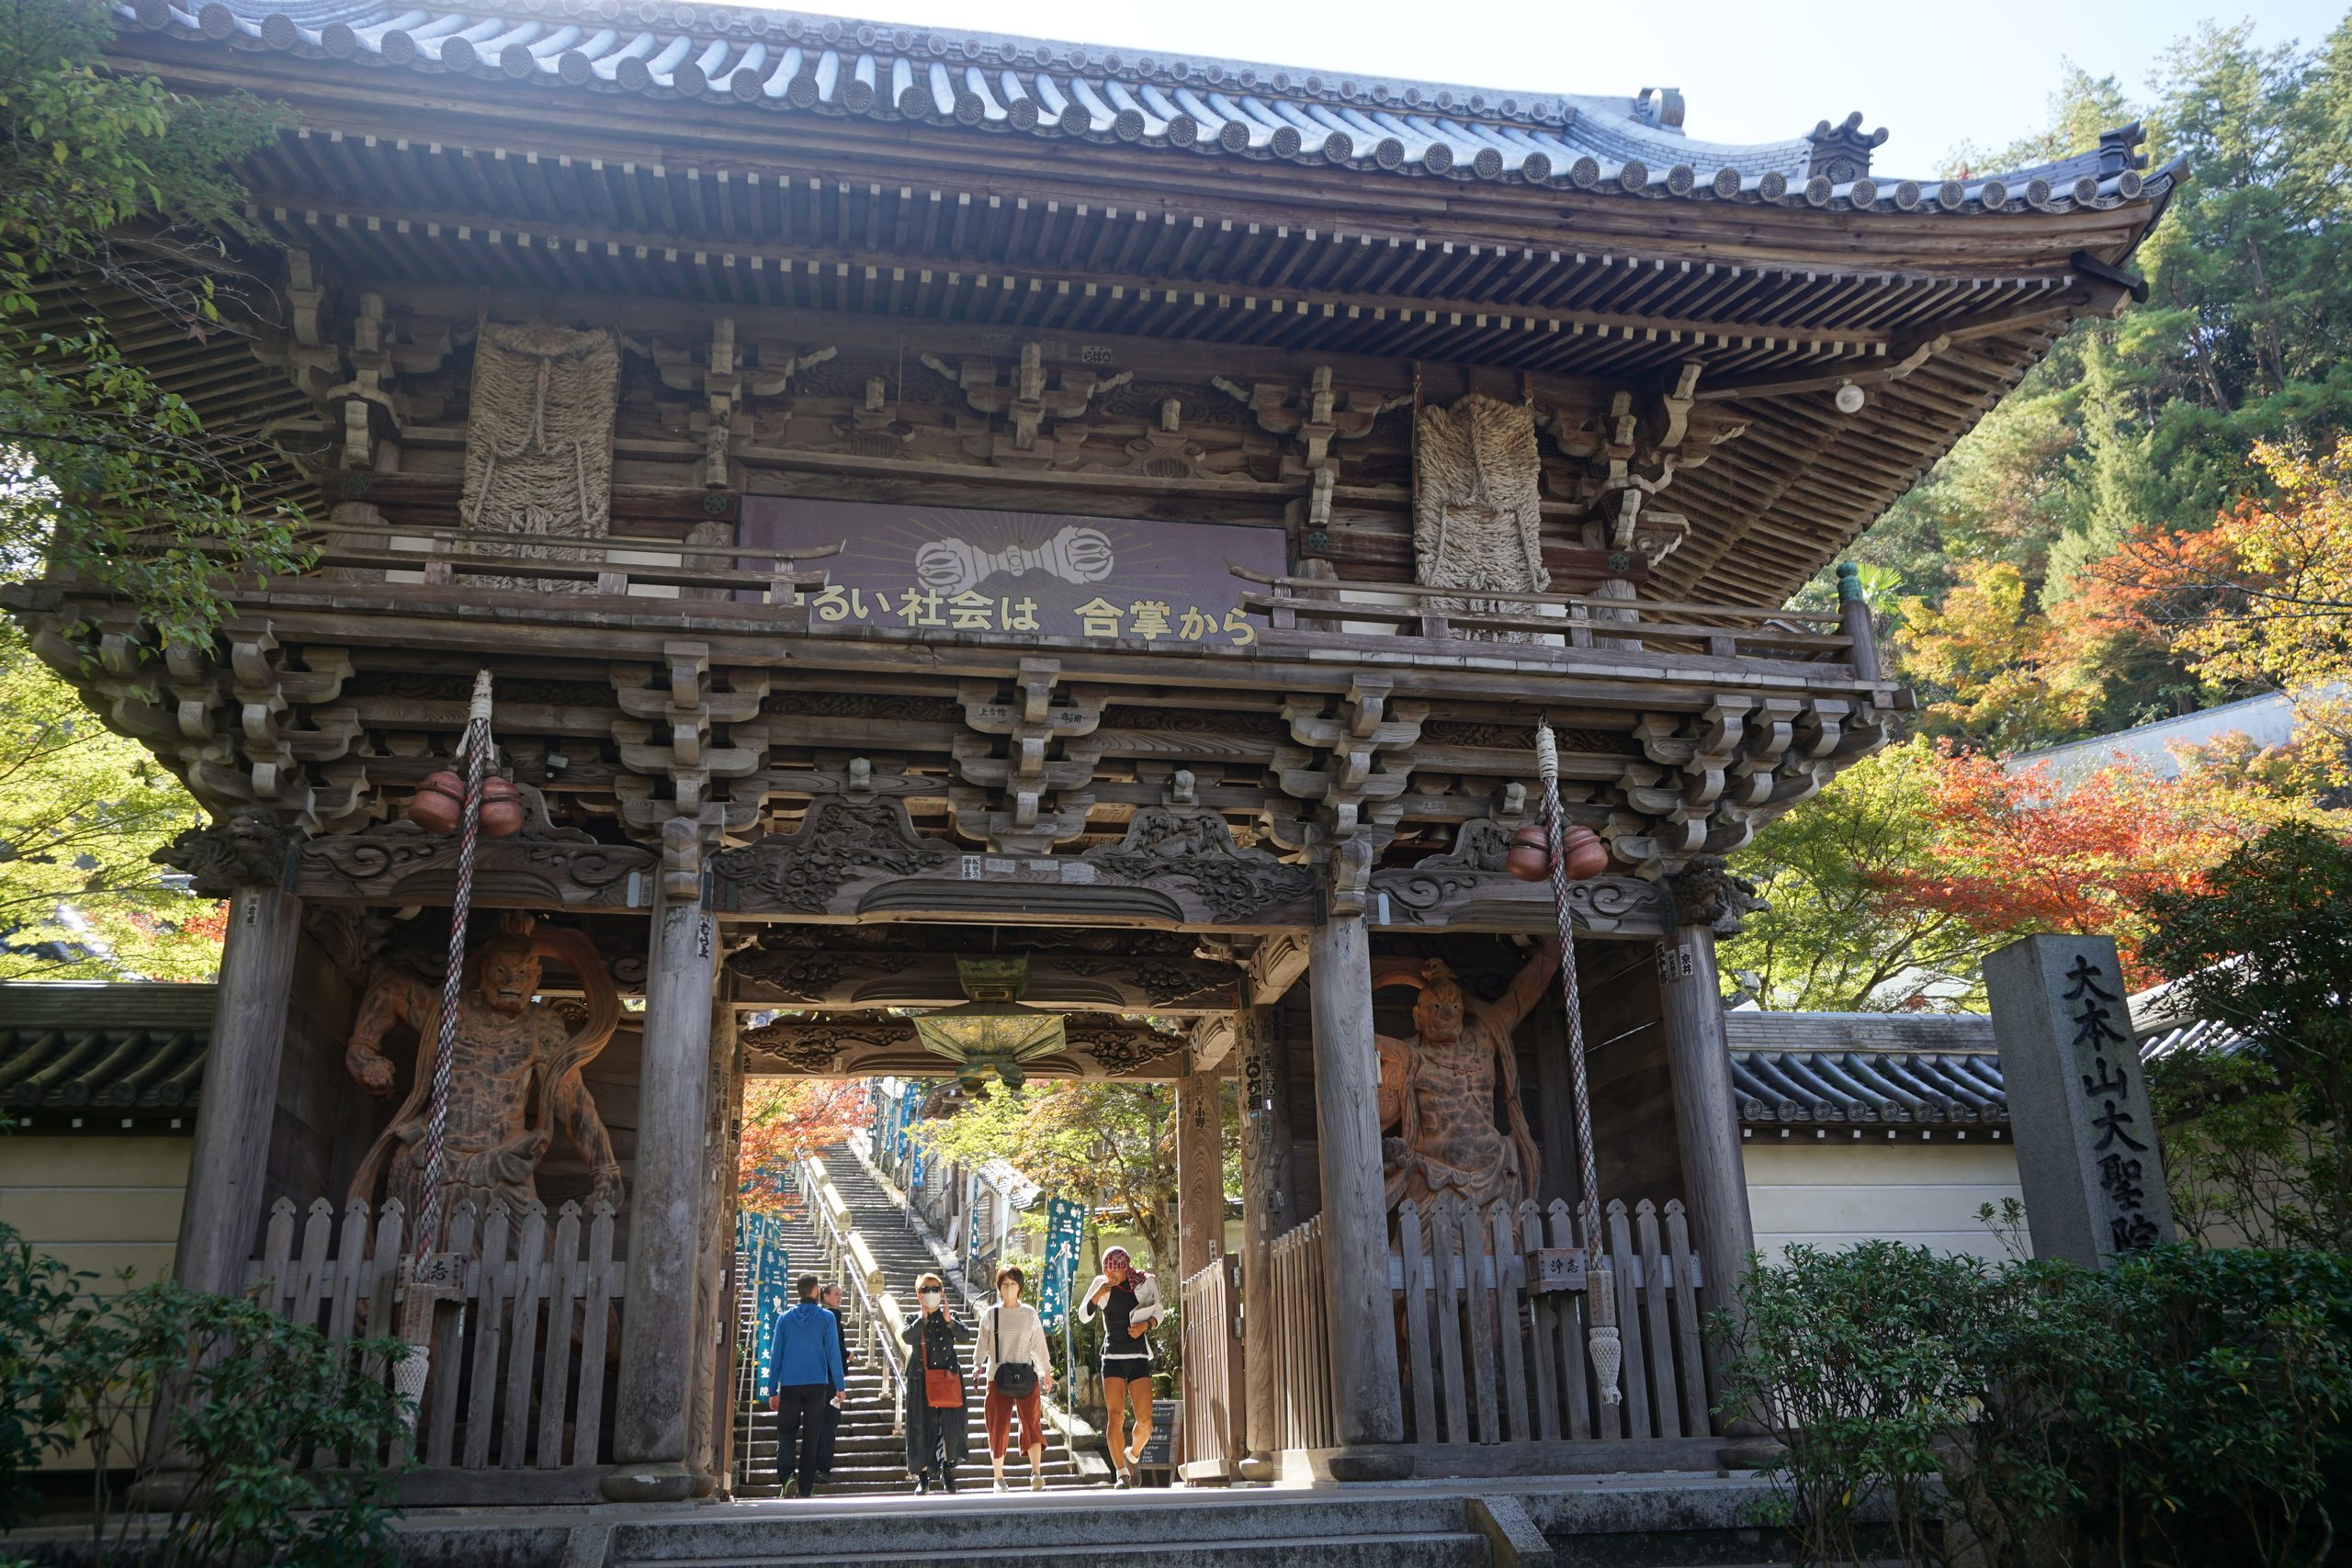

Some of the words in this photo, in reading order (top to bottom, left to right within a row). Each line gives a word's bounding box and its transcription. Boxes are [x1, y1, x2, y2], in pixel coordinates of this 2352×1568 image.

[1072, 597, 1255, 646] 合掌から
[2062, 953, 2159, 1253] 大本山大聖院
[759, 1348, 771, 1397] 大聖院
